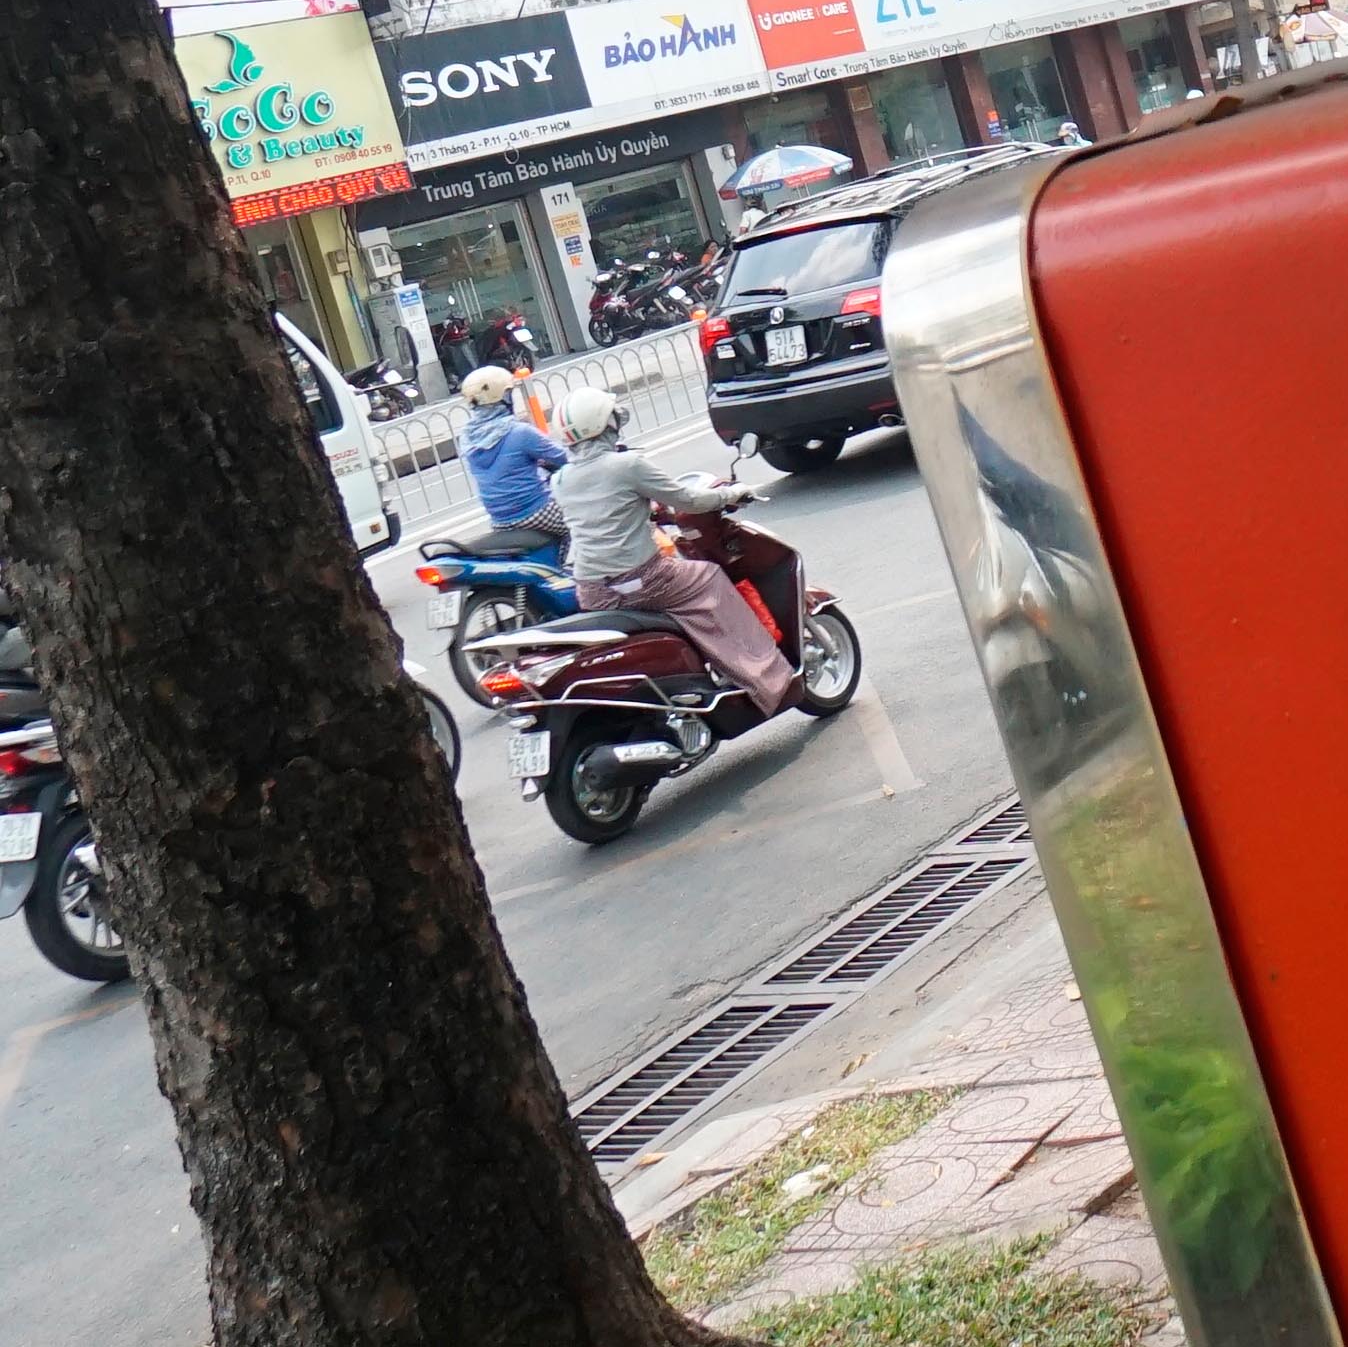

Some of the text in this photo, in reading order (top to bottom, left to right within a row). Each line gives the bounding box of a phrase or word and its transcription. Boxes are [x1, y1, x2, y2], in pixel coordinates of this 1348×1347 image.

[772, 2, 849, 26] GIONEE CARE
[604, 31, 656, 69] BẢO
[400, 48, 556, 108] SONY
[776, 67, 811, 87] Smart
[813, 65, 837, 80] Care
[843, 61, 869, 74] Trung
[869, 56, 889, 69] Tâm
[689, 92, 707, 103] 7171
[227, 123, 366, 169] & Beauty
[334, 150, 358, 164] 0908
[357, 148, 370, 159] 40
[370, 145, 383, 156] 55
[382, 143, 393, 154] 19
[408, 149, 426, 164] 171
[437, 143, 470, 159] Tháng
[469, 140, 477, 151] 2
[483, 136, 501, 148] P.11
[508, 131, 530, 144] Q.10
[536, 126, 549, 136] TP
[549, 120, 571, 133] HCM
[421, 131, 670, 204] Trung Tâm Bảo Hành Ủy Quyền
[551, 192, 570, 206] 171
[774, 329, 795, 347] 51A
[768, 343, 806, 363] 54473
